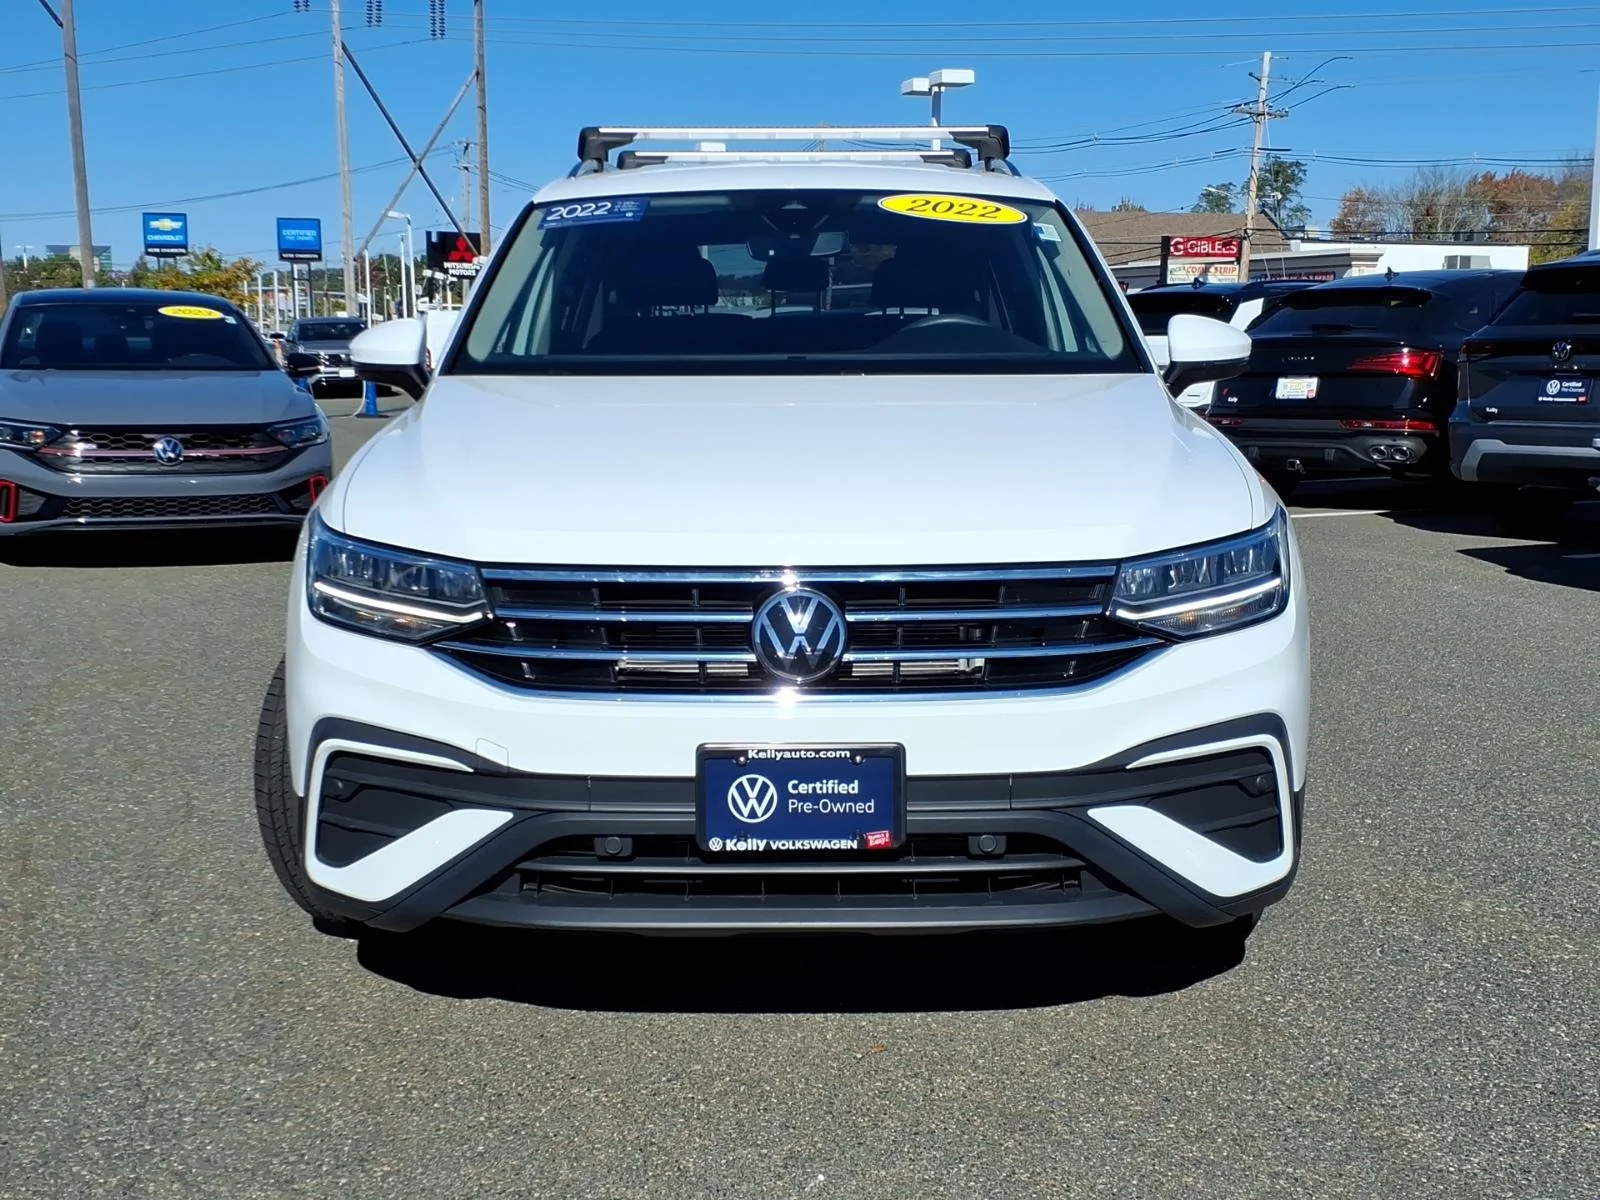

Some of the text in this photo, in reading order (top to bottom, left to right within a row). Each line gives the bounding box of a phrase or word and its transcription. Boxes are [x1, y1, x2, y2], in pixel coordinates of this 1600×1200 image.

[546, 202, 612, 220] 2022
[905, 199, 1003, 219] 2022
[1214, 266, 1237, 274] STRIP
[748, 750, 851, 760] Kellyauto.com
[787, 780, 859, 794] Certified
[788, 799, 875, 813] Pre-Owned
[725, 838, 767, 851] Kelly
[769, 840, 858, 850] VOLKSWAGEN
